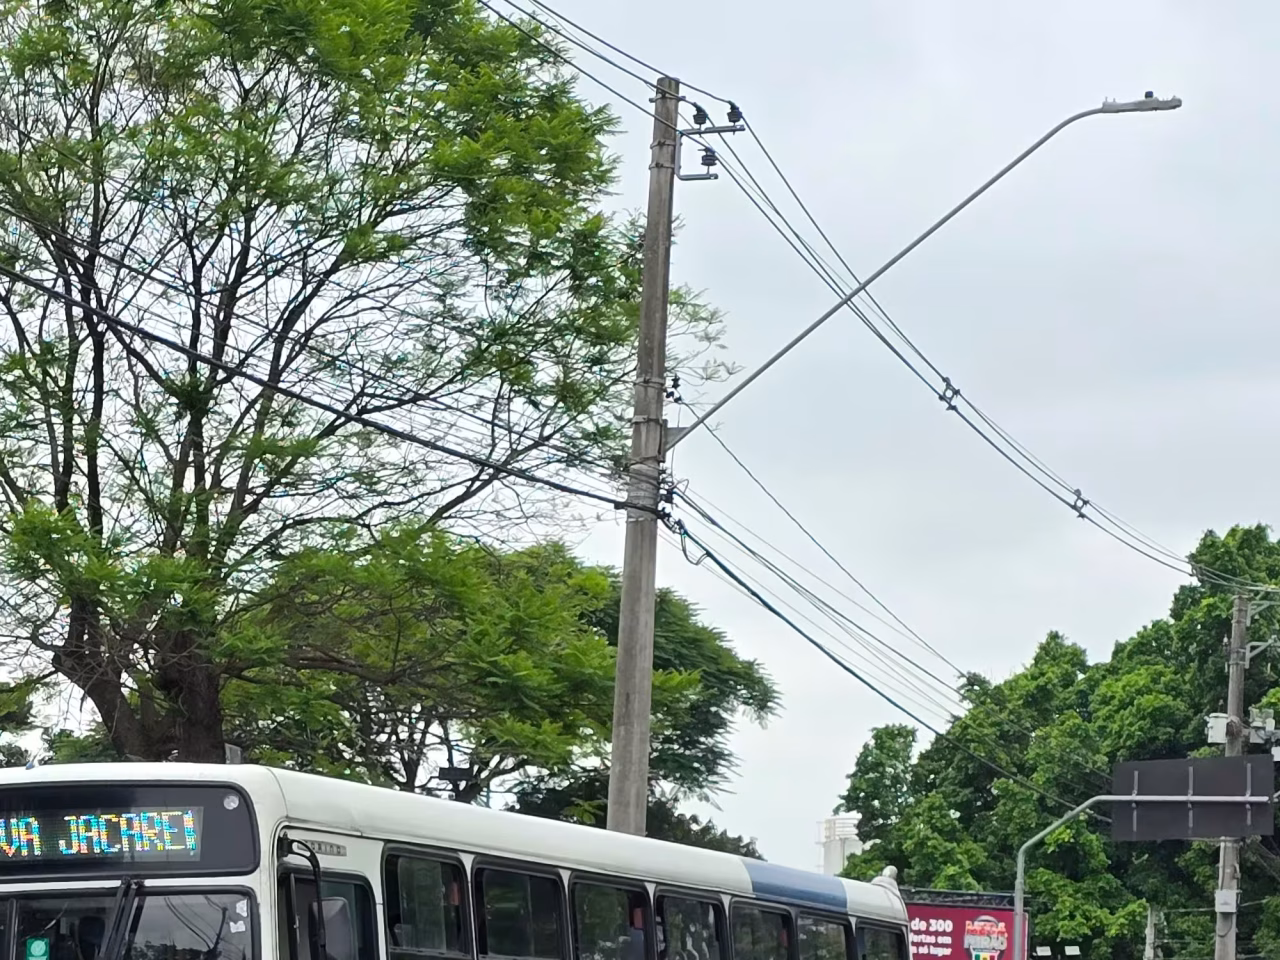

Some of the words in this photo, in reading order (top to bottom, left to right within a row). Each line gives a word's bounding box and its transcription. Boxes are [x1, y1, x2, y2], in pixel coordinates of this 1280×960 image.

[910, 917, 927, 931] de
[929, 919, 953, 932] 300
[937, 936, 952, 944] em
